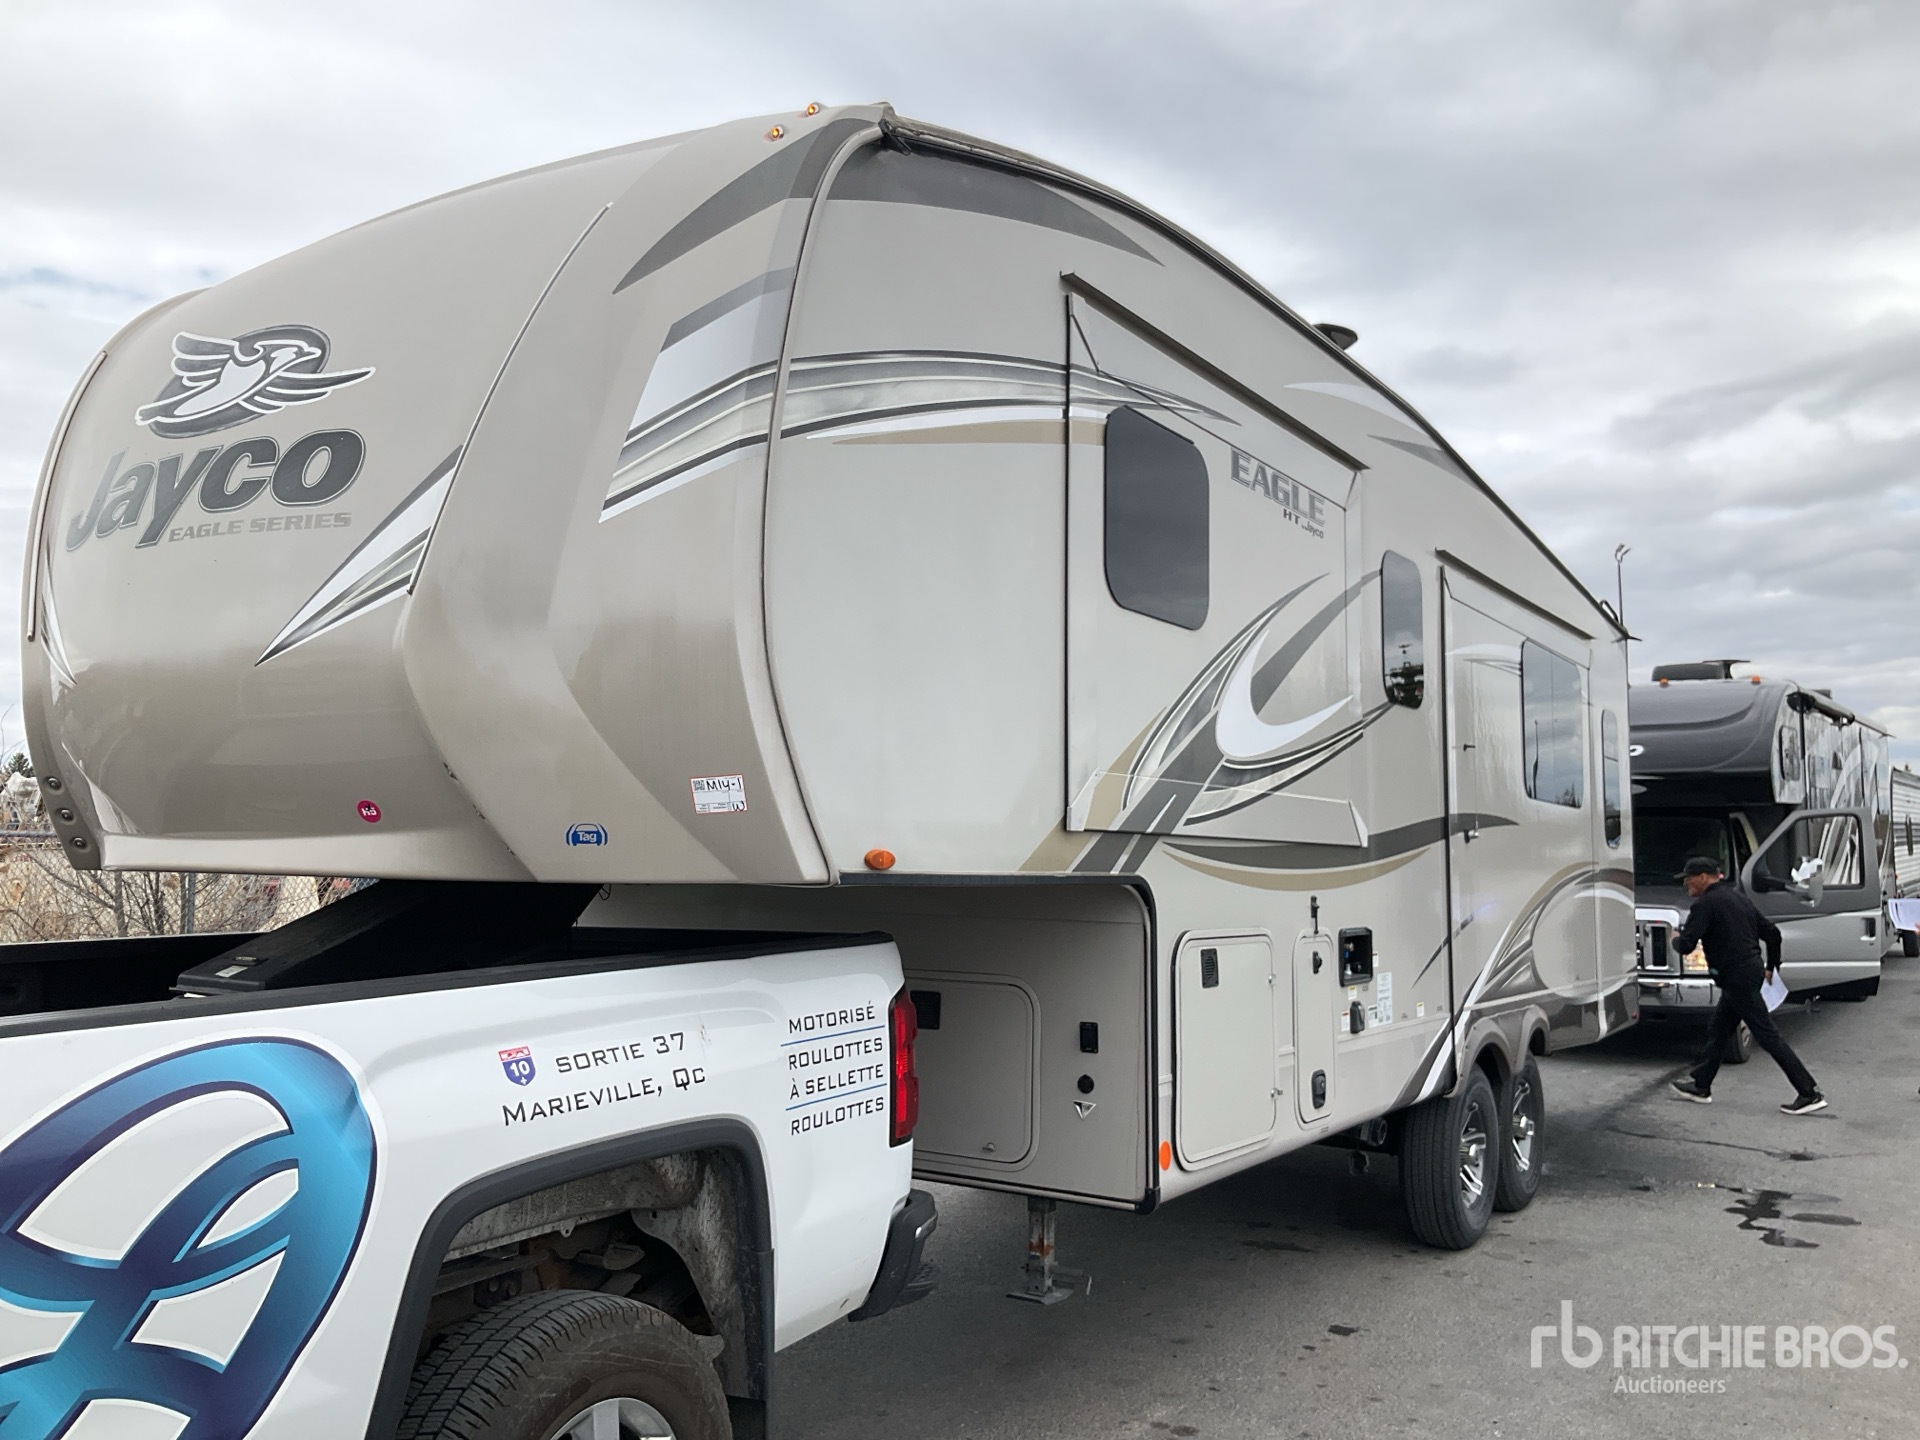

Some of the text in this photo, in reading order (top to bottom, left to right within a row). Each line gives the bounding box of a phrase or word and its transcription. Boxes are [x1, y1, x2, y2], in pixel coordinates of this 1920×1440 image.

[65, 428, 366, 552] Jayco
[1230, 447, 1326, 527] EAGLE
[168, 512, 353, 543] EAGLE SERIES
[1283, 508, 1301, 525] HT
[577, 831, 597, 843] Tag
[789, 1000, 876, 1034] MOTORISÉ
[510, 1060, 531, 1077] 10
[556, 1031, 684, 1073] SORTIE 37
[788, 1037, 883, 1070] ROULOTTES
[790, 1063, 884, 1100] À SELLETTE
[791, 1096, 884, 1136] ROULOTTES
